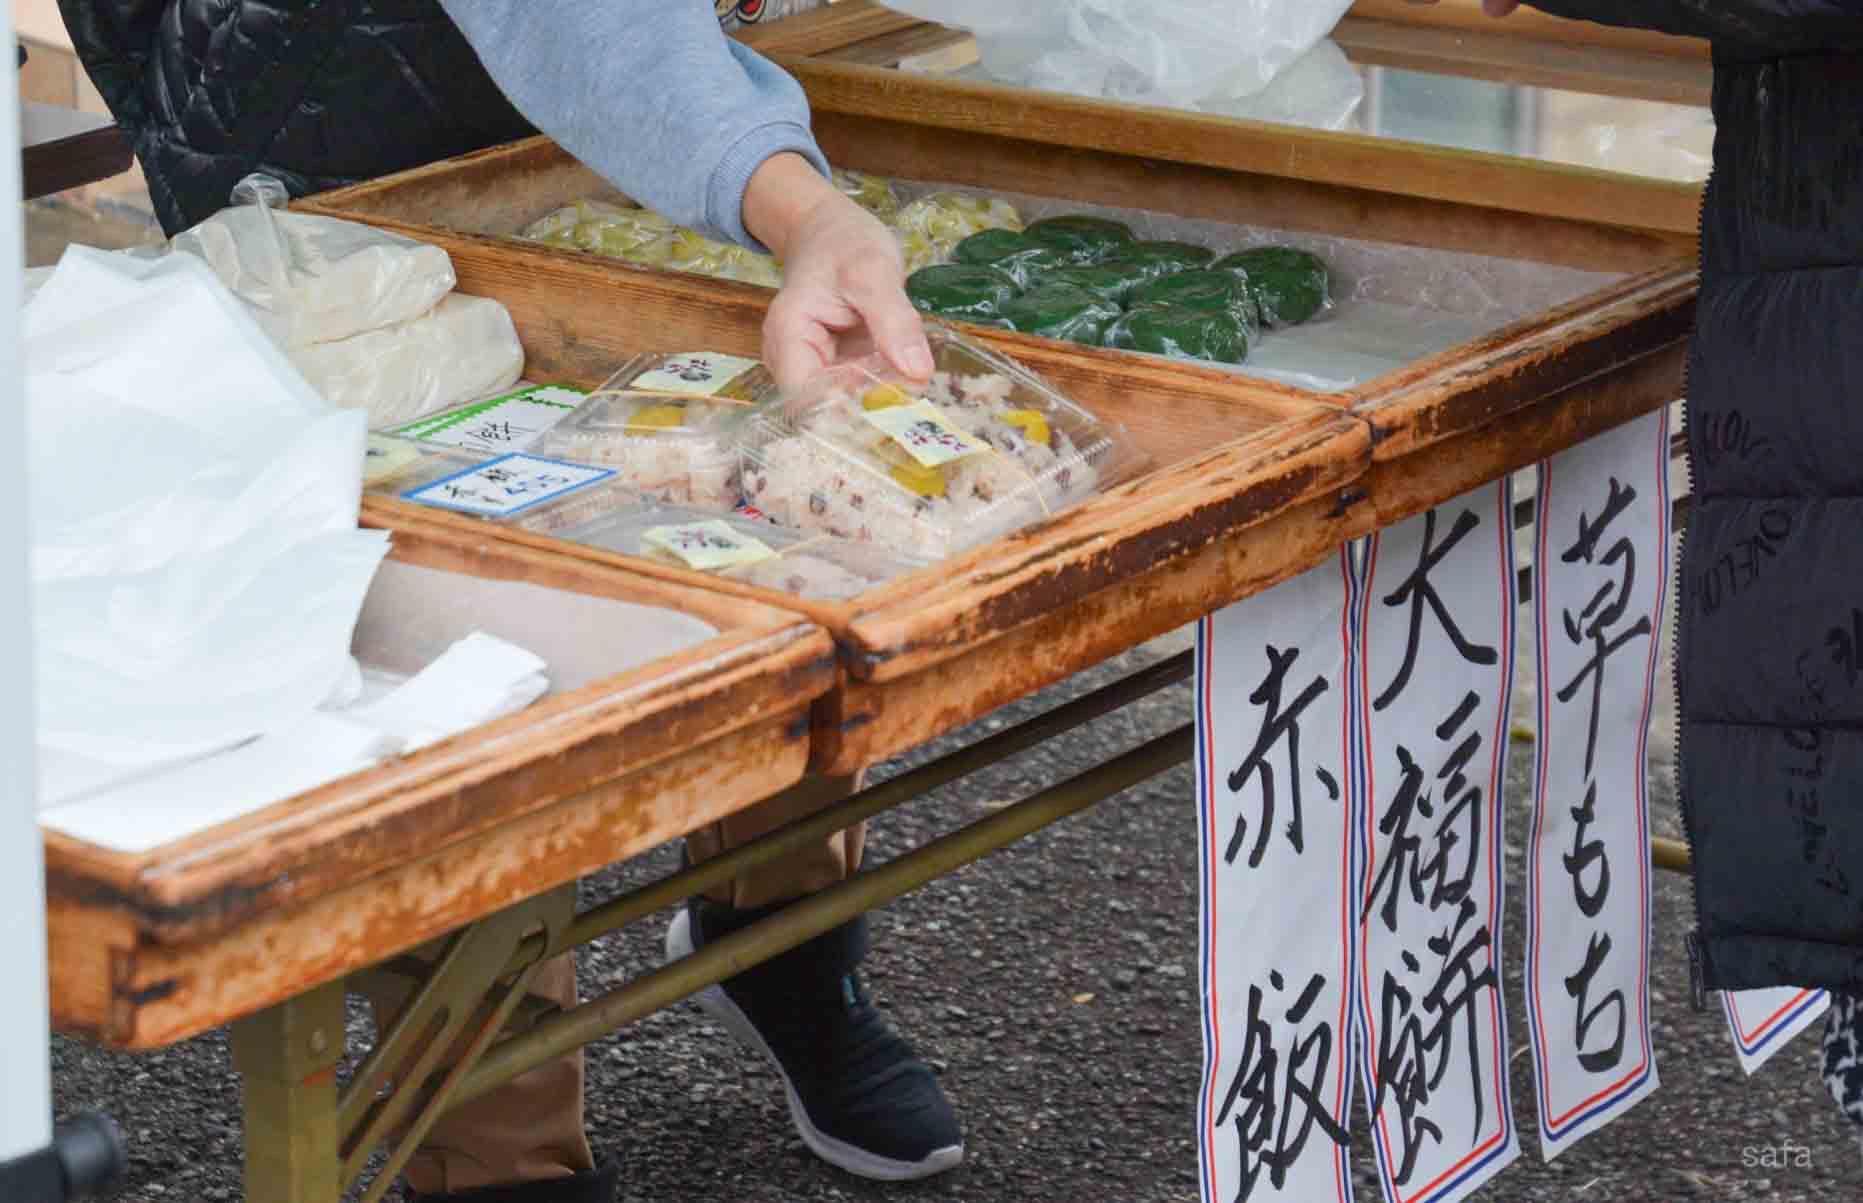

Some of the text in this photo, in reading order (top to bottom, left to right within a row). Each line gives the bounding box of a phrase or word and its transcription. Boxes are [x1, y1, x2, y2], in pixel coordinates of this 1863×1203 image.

[1215, 644, 1351, 1203] 赤飯
[1360, 509, 1499, 1186] 大福餅
[1556, 477, 1651, 1073] 草もち
